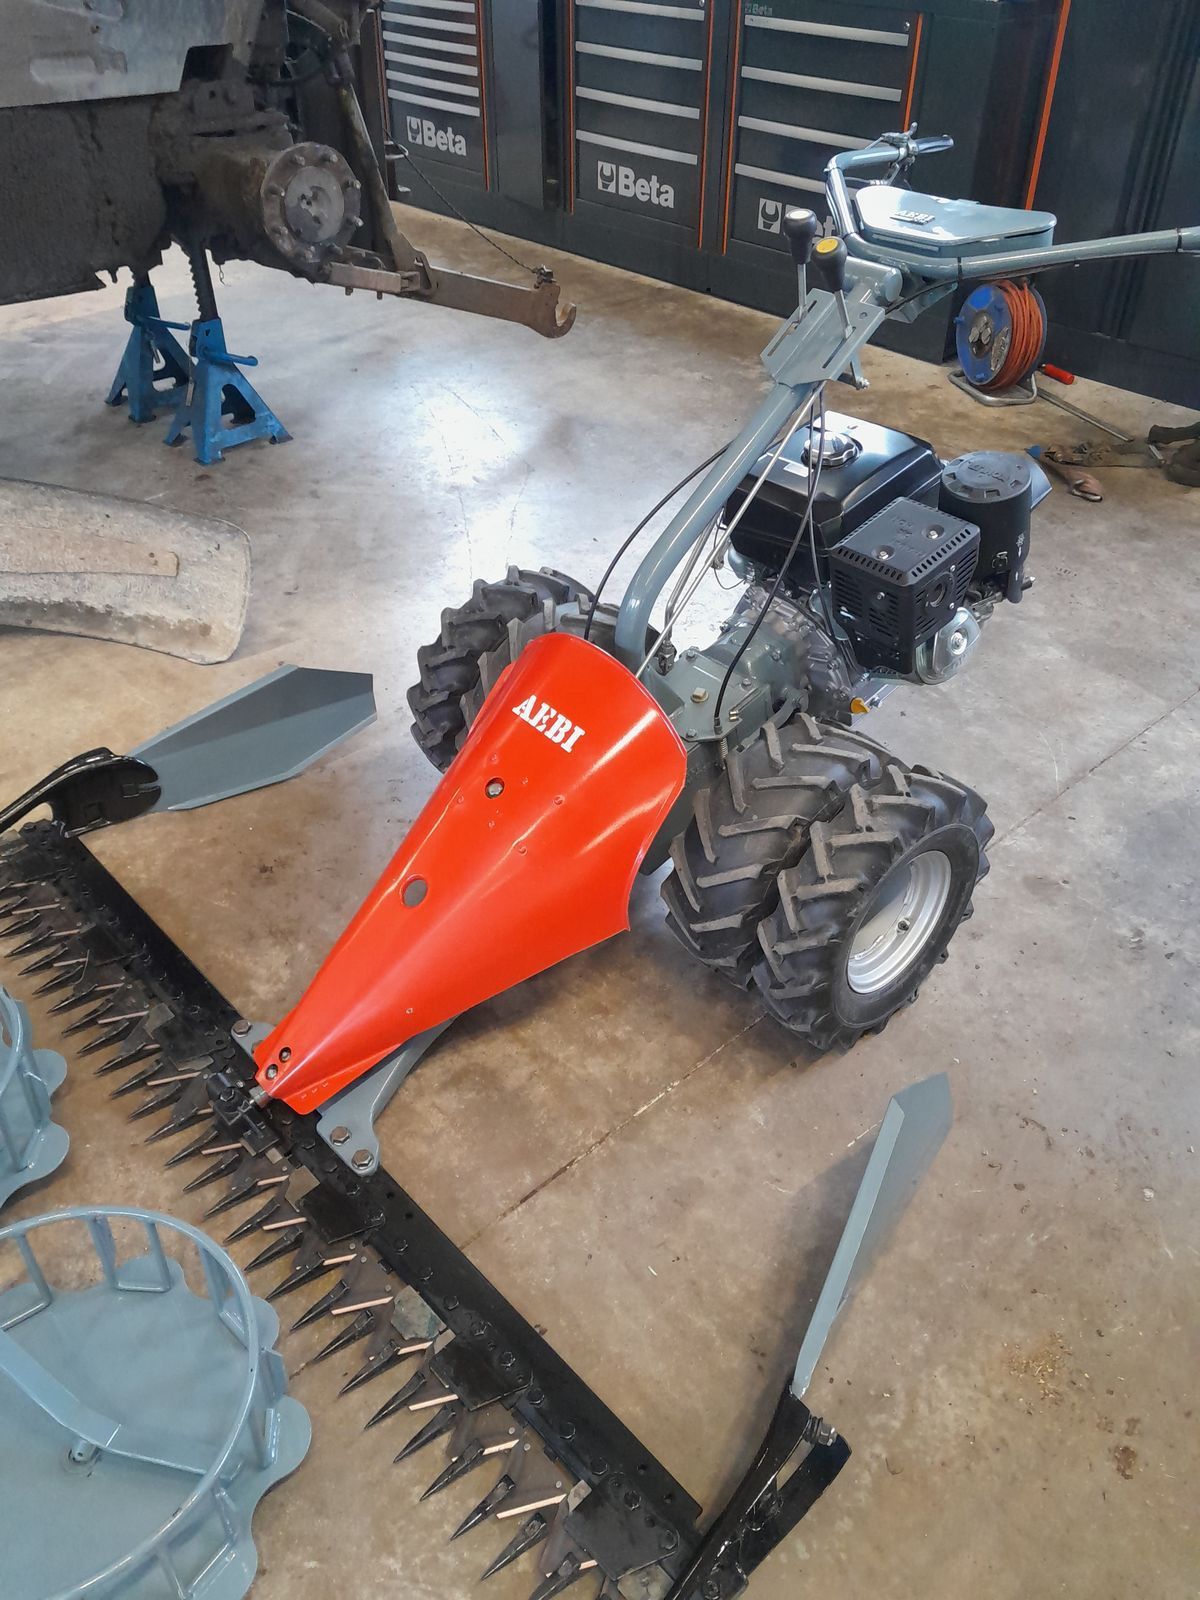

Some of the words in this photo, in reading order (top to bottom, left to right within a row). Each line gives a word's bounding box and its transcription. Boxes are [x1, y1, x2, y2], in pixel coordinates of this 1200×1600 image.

[422, 119, 467, 156] Beta
[618, 165, 674, 209] Beta
[511, 694, 586, 753] AEBI
